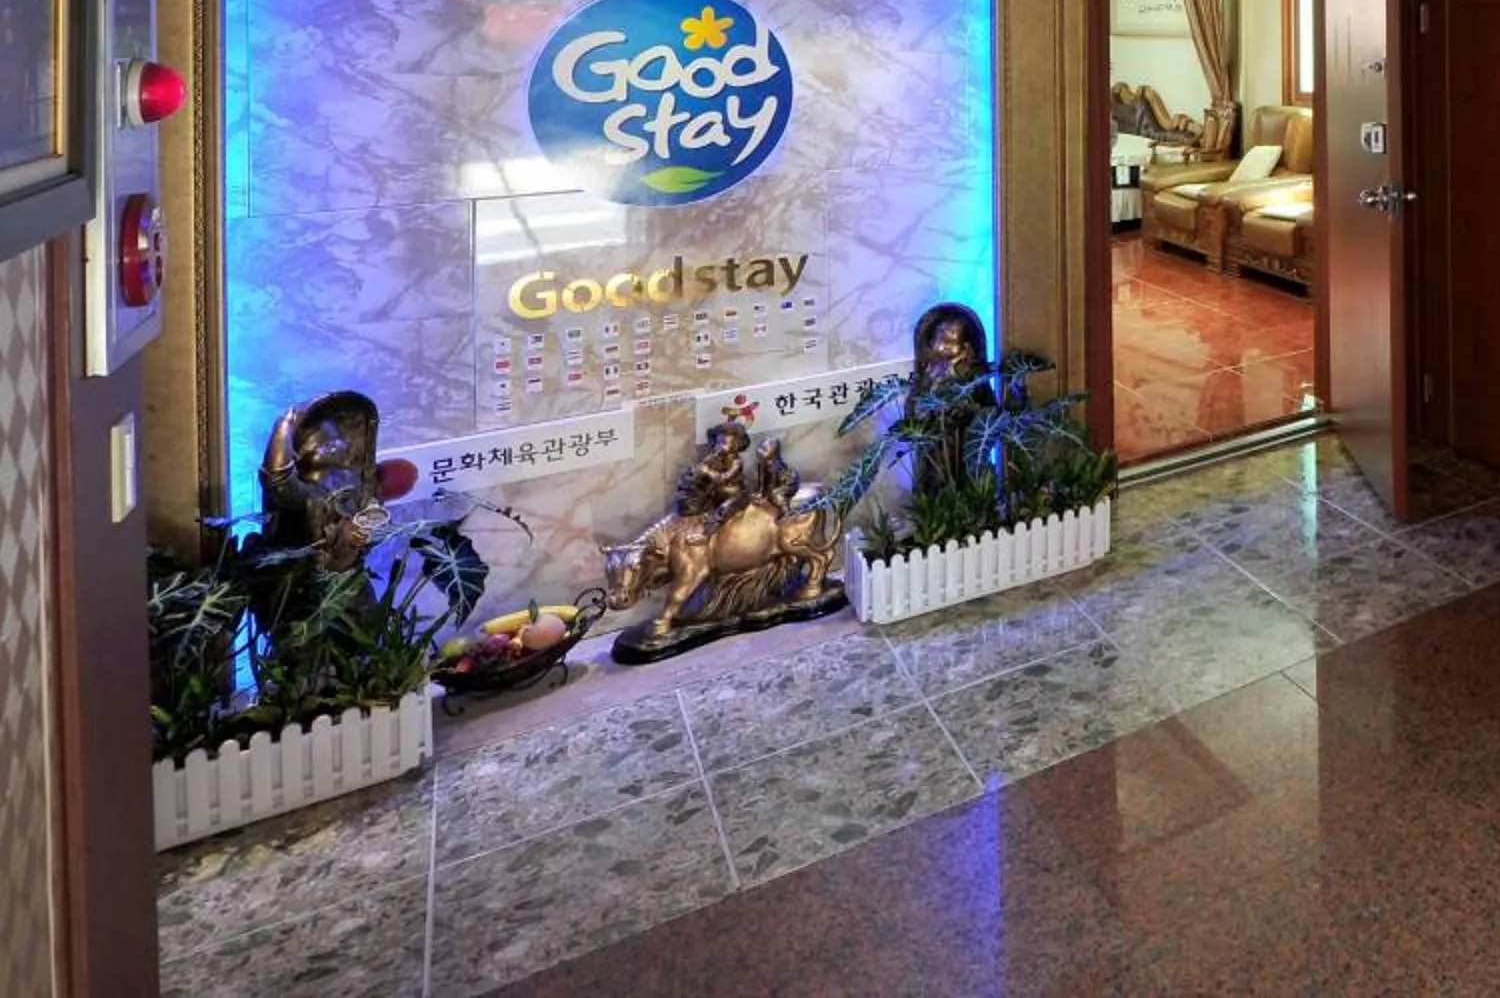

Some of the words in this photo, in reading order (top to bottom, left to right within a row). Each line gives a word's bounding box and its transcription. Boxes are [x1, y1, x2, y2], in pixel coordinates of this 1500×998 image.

[553, 20, 780, 102] Good
[603, 91, 778, 167] stay
[774, 372, 914, 416] 한국관광
[429, 428, 618, 484] 문화체육관광부
